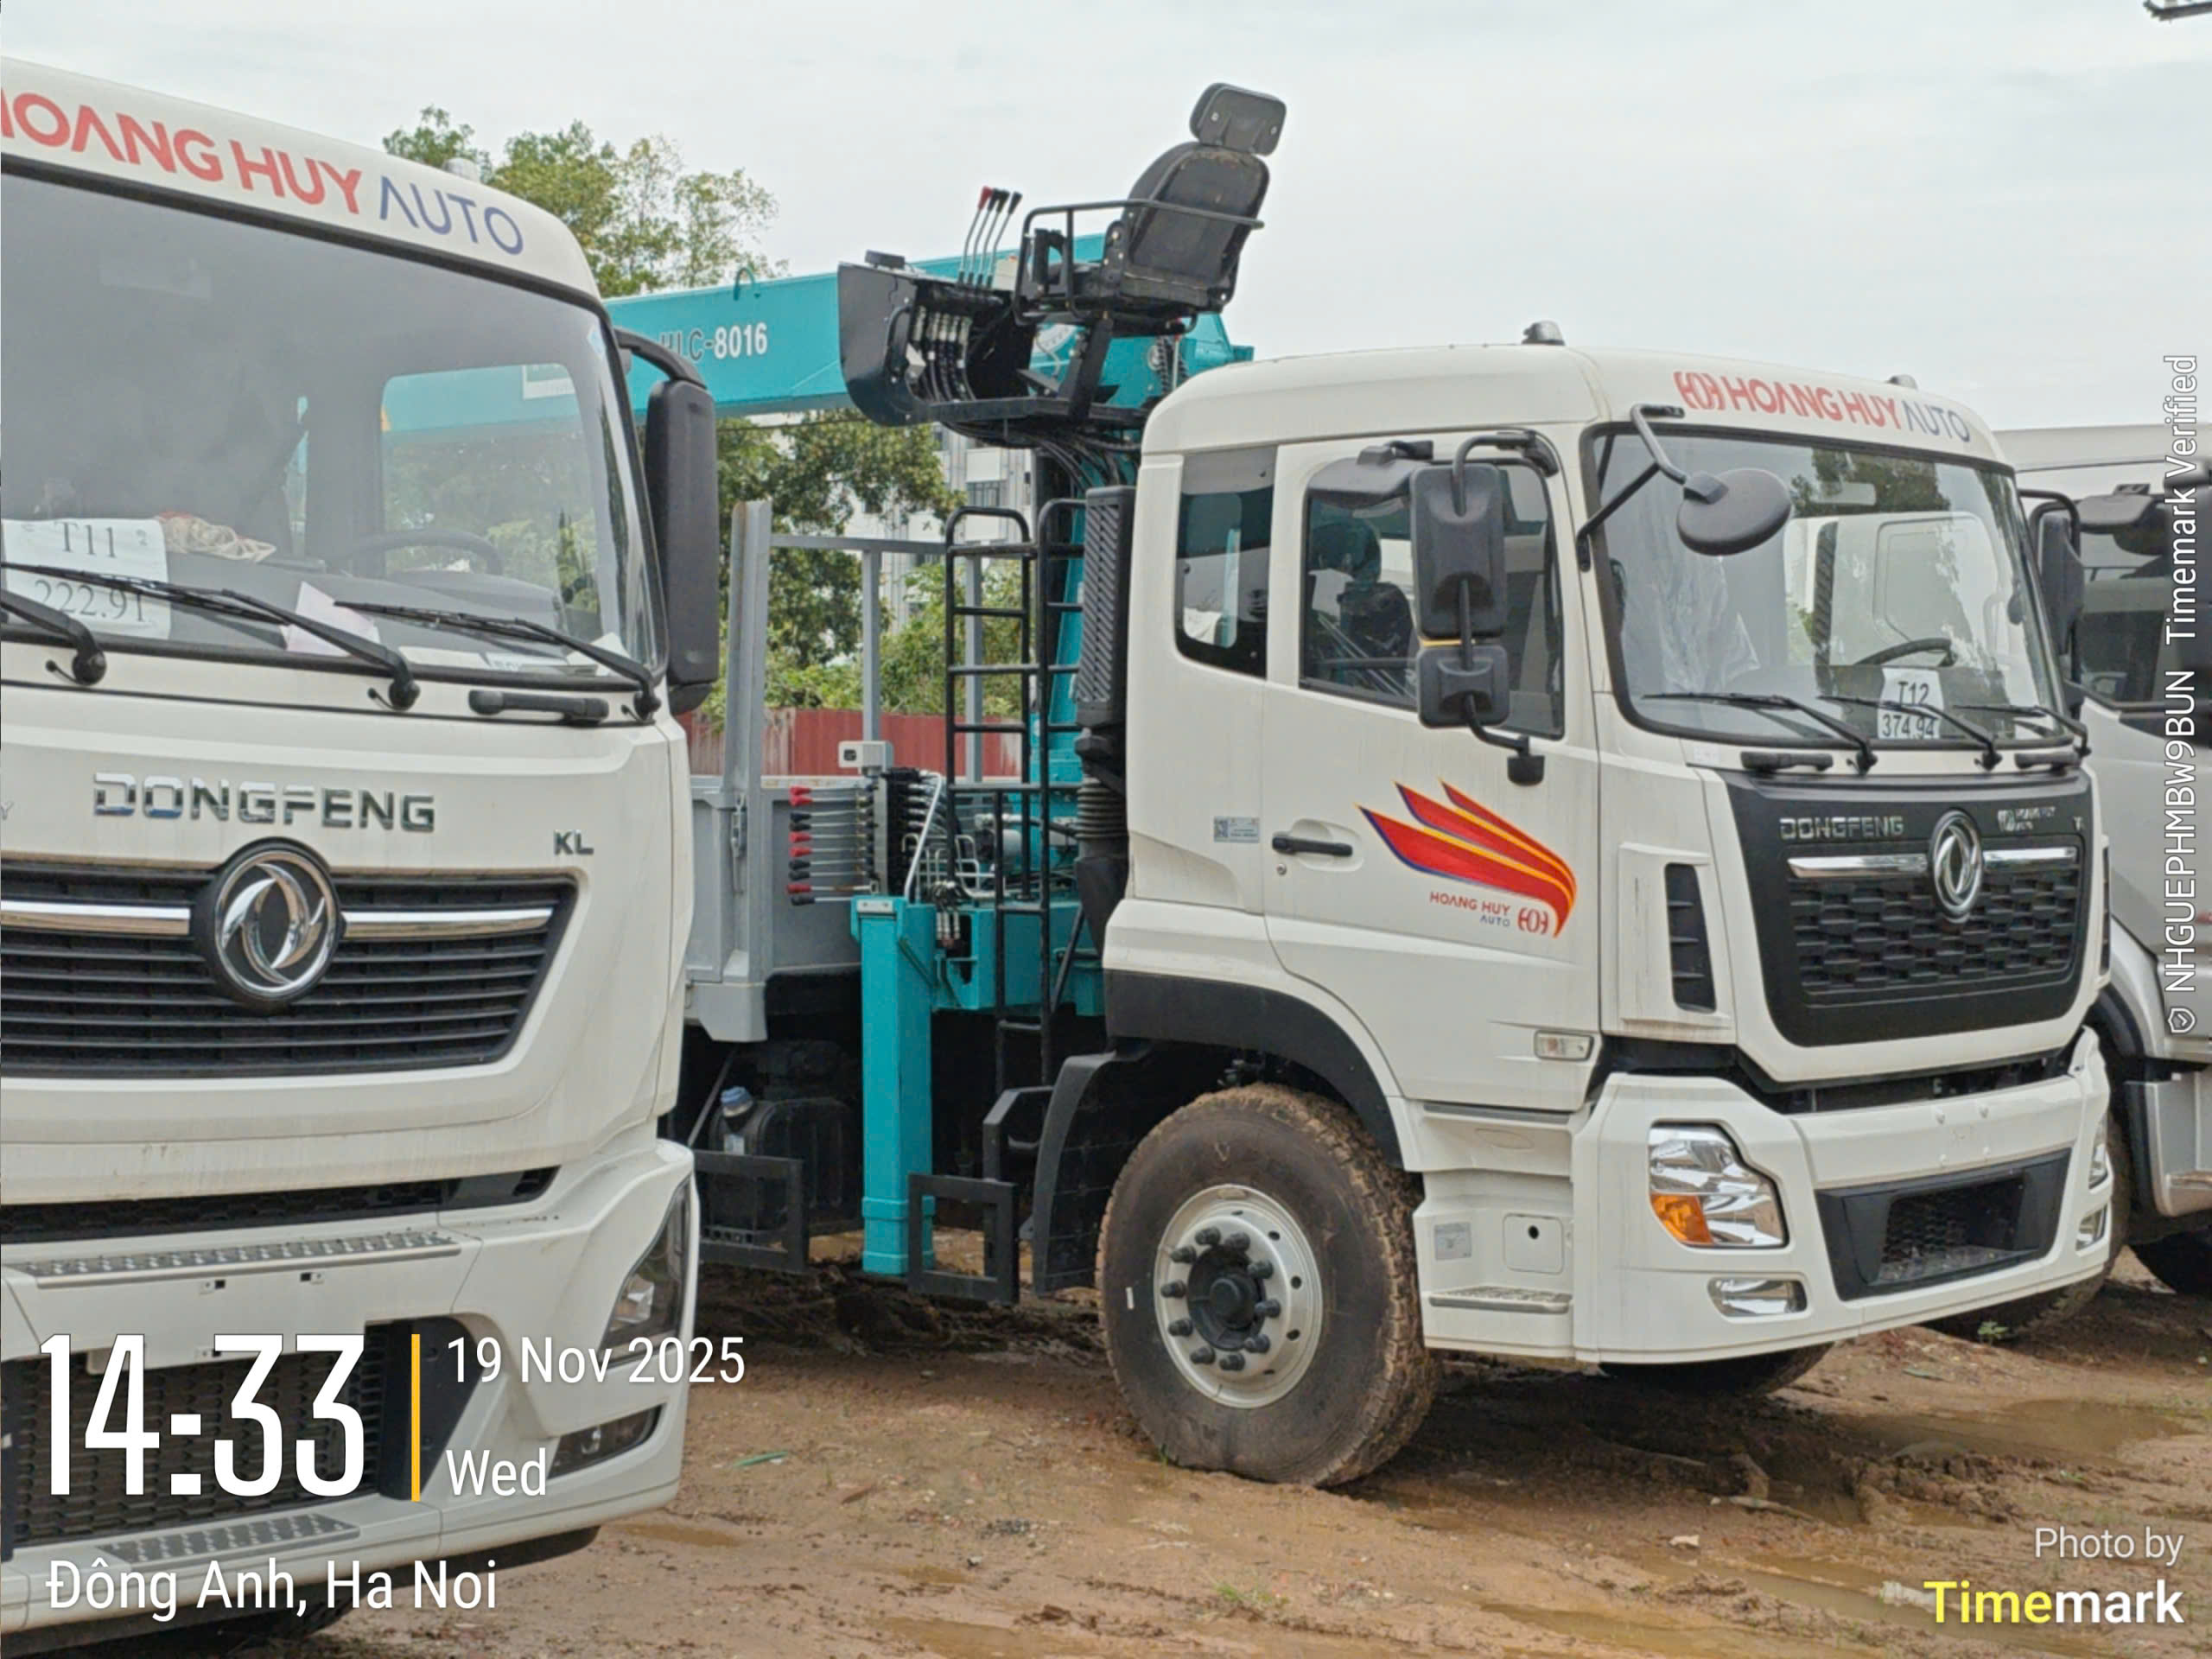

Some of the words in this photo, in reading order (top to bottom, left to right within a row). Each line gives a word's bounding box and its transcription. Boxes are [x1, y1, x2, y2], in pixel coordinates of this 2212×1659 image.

[0, 88, 223, 181] OANG
[229, 140, 363, 214] HUY
[378, 175, 524, 255] AUTO
[1722, 376, 1844, 421] HOANG
[1840, 391, 1904, 429] HUY
[1899, 399, 1972, 442] AUTO
[54, 521, 117, 558] T11
[1897, 681, 1929, 707] T12
[93, 772, 435, 832] DONGFENG
[1779, 816, 1904, 839] DONGFENG
[554, 829, 594, 855] KL
[1430, 891, 1478, 911] HOANG
[1481, 900, 1510, 916] HUY
[1480, 914, 1510, 927] AUTO
